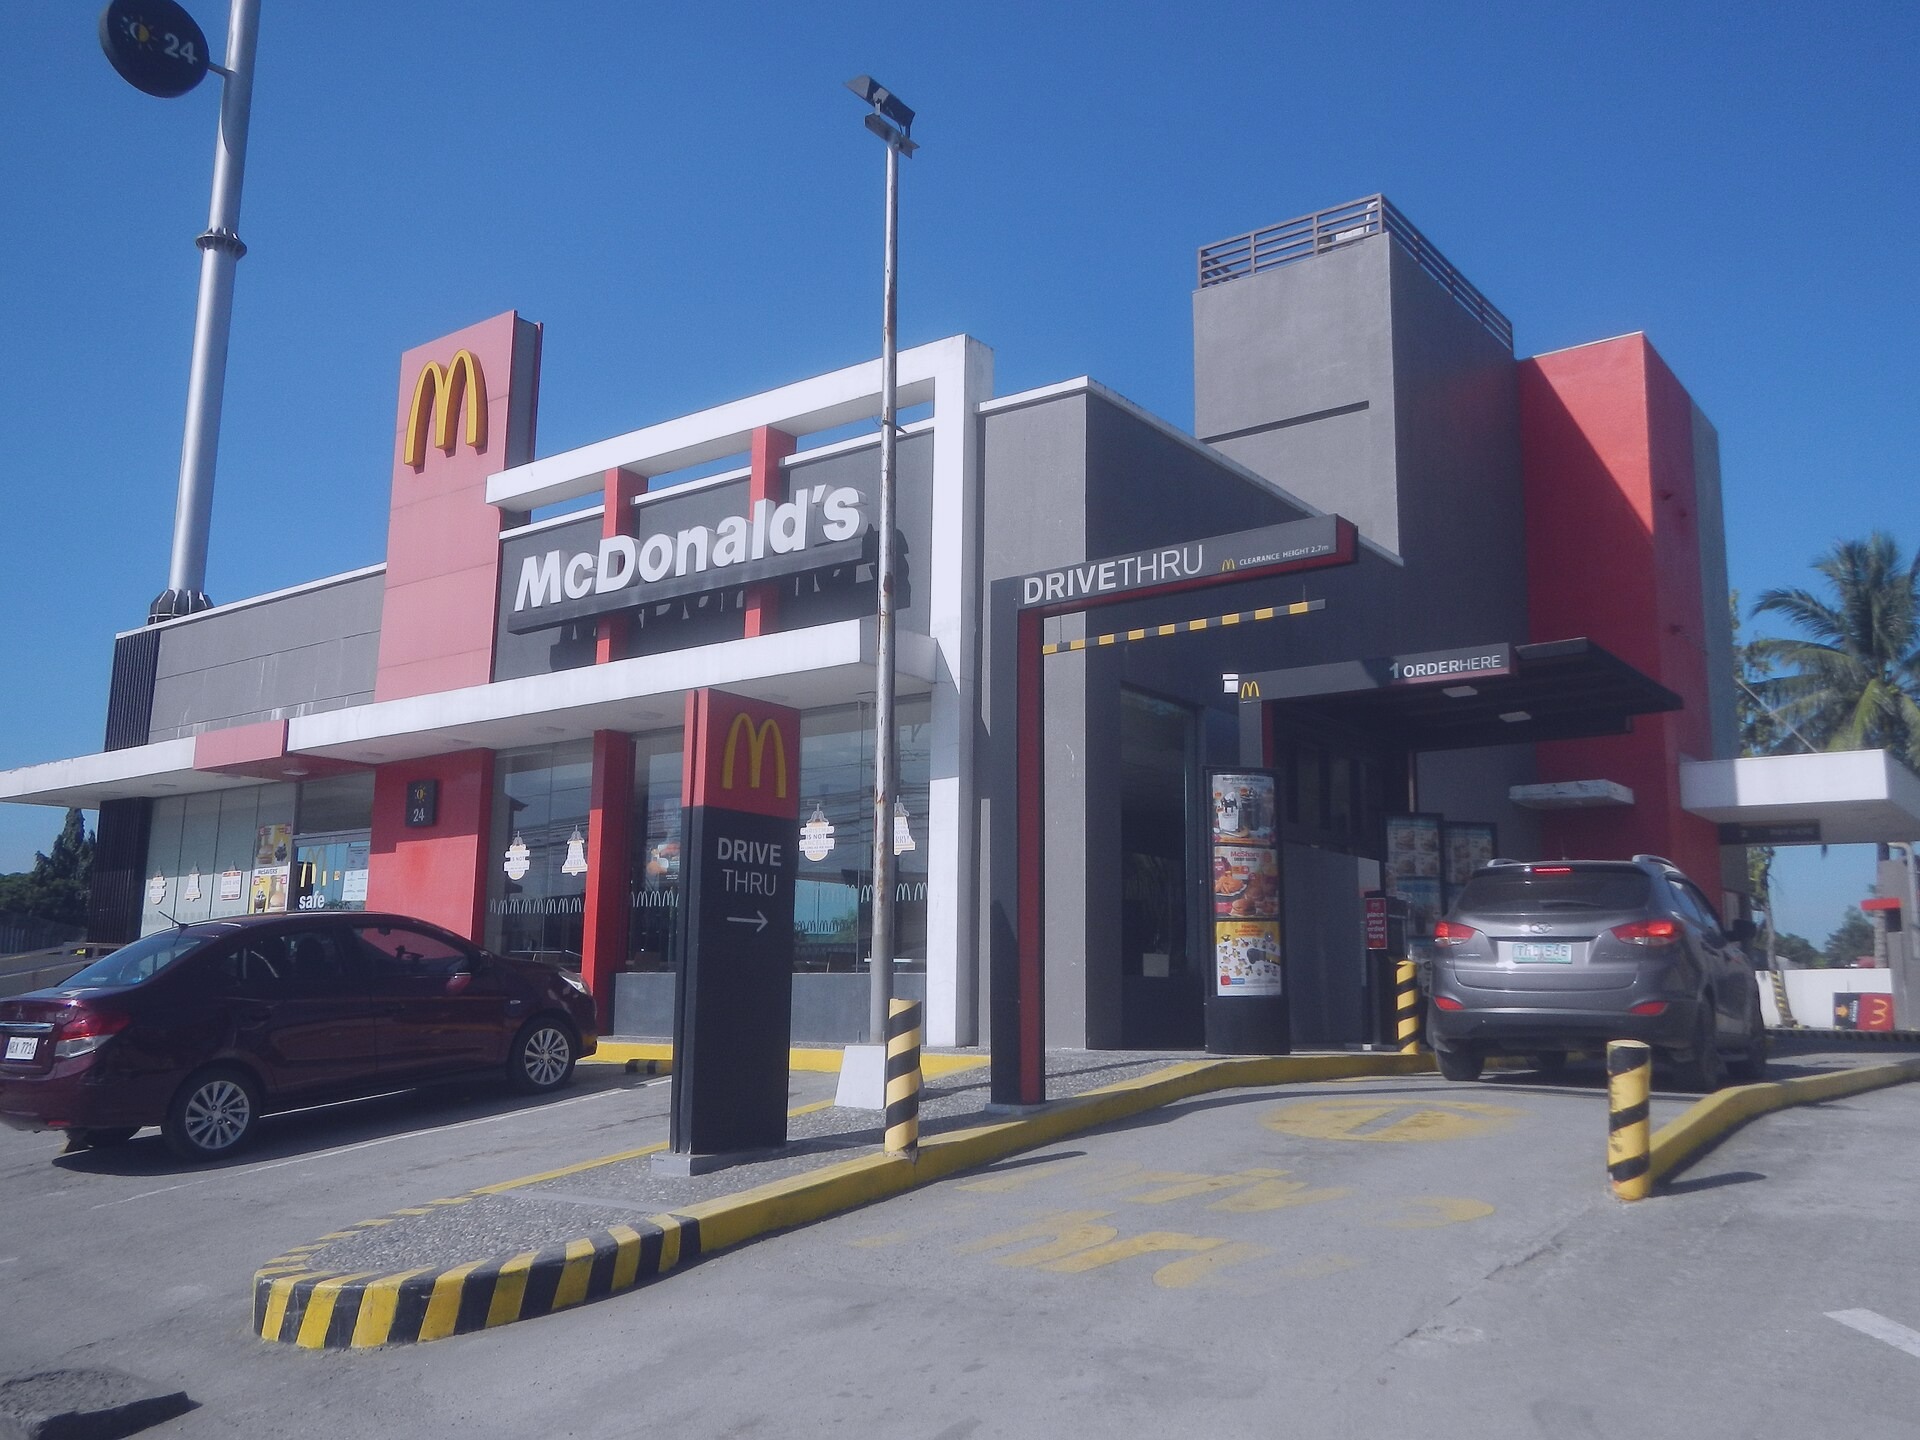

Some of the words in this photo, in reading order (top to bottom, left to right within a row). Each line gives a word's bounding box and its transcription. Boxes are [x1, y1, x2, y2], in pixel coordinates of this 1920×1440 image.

[163, 33, 198, 64] 24
[514, 484, 865, 612] McDonald's
[1239, 552, 1280, 566] CLEARANCE
[1282, 547, 1309, 558] HEIGHT
[413, 808, 425, 822] 24
[717, 837, 782, 867] DRIVE
[722, 868, 777, 896] THRU
[299, 891, 325, 909] safe
